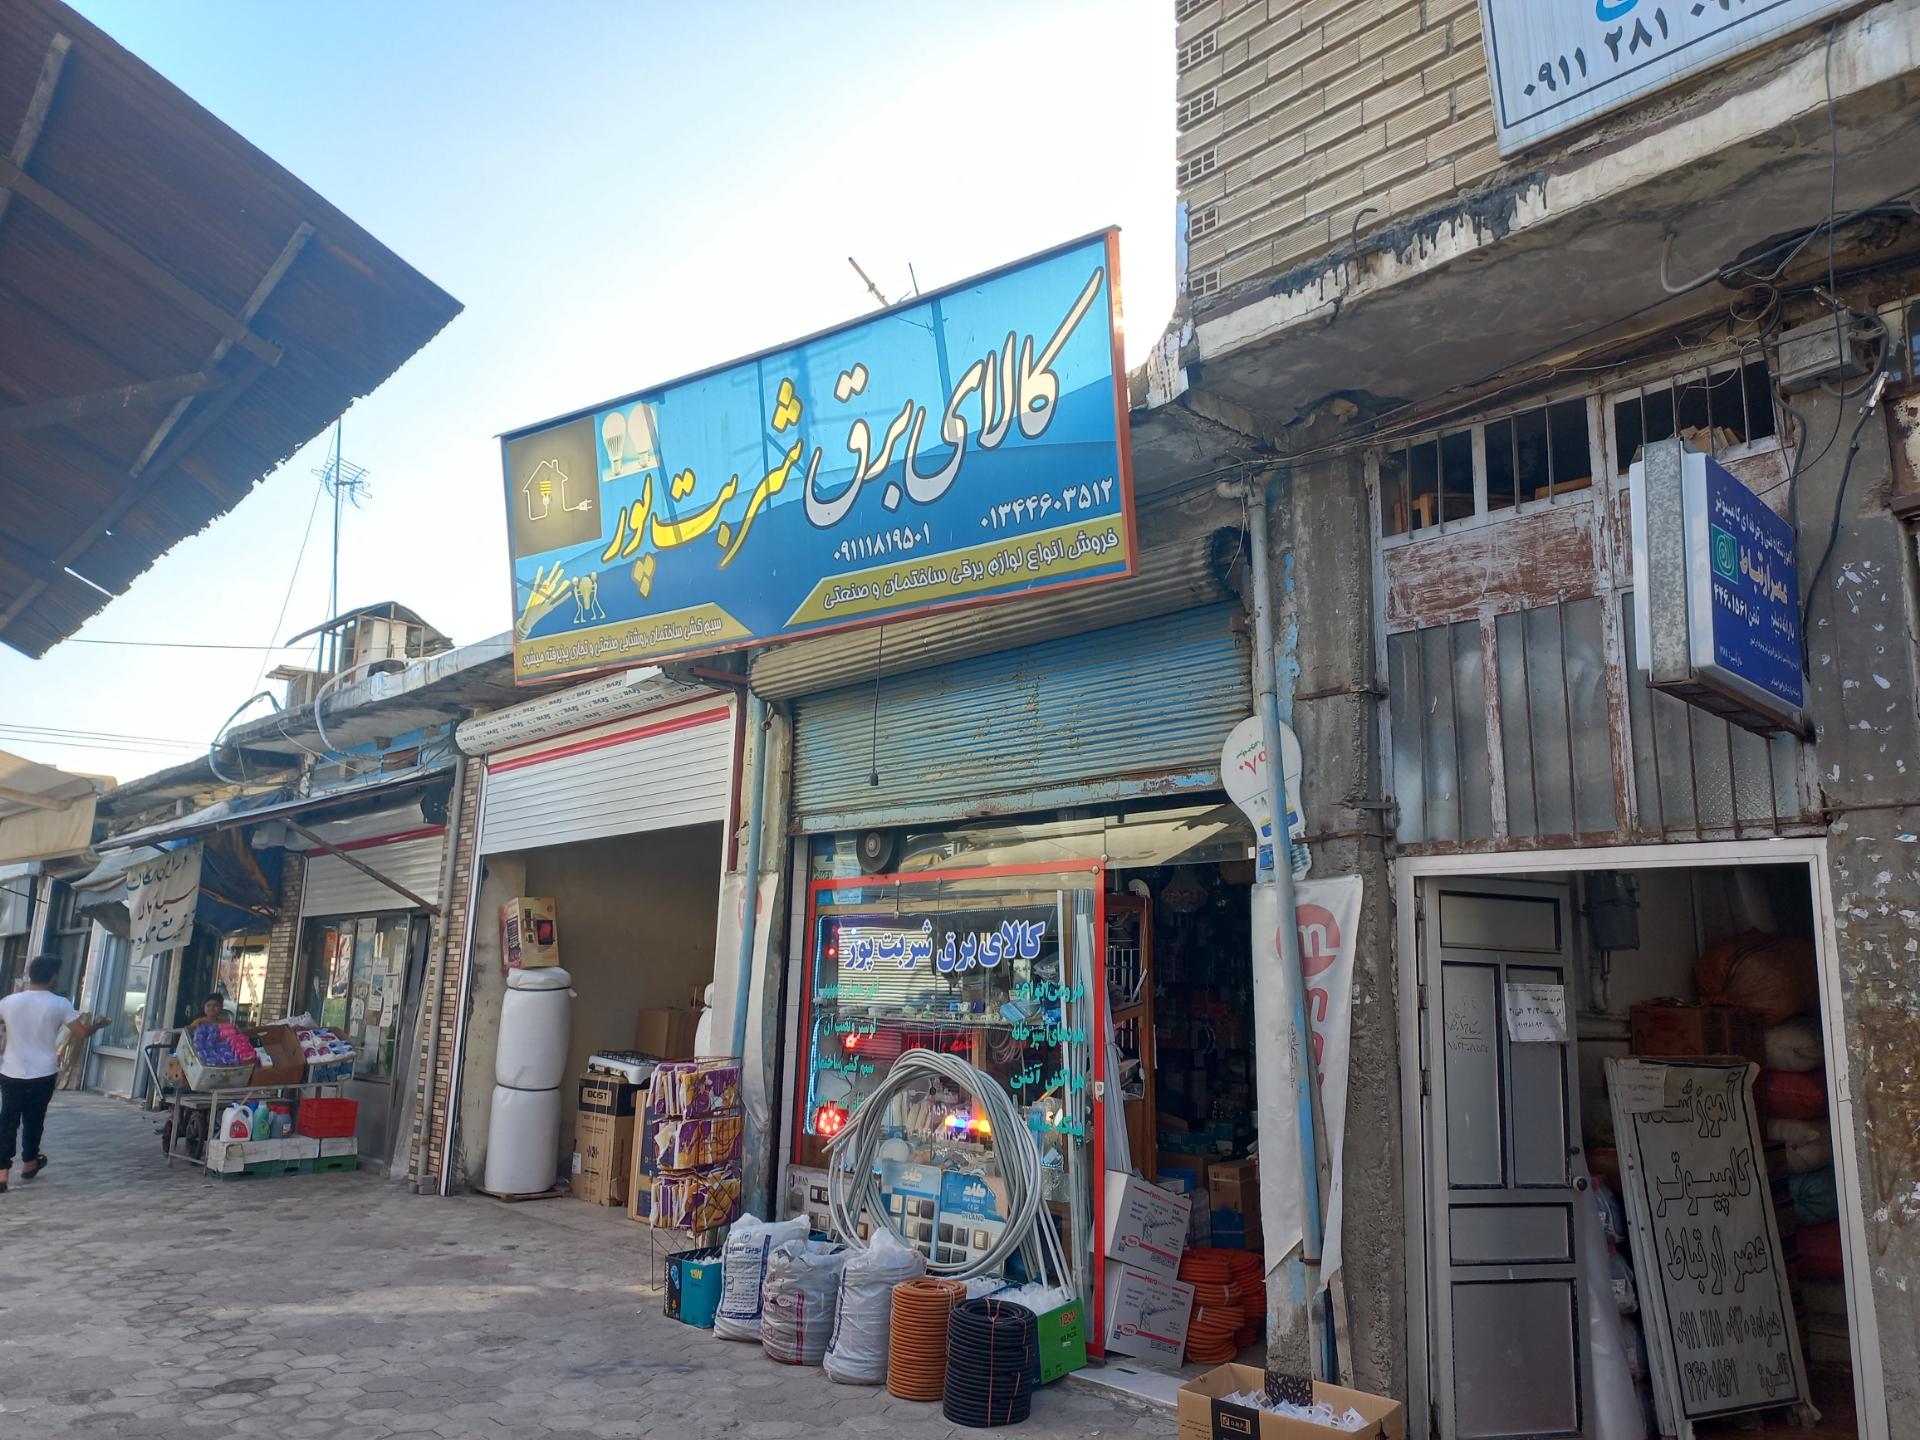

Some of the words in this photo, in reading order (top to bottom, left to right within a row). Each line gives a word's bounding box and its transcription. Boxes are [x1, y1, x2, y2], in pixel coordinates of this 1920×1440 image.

[1523, 47, 1587, 97] ۰۹۱۱
[1604, 8, 1669, 63] ۲۸۱
[904, 265, 1105, 504] کالای
[803, 362, 915, 530] برق
[648, 376, 804, 571] شربت
[980, 476, 1113, 530] ۰۱۳۴۴۶۰۳۵۱۲
[601, 472, 655, 600] پور
[1067, 527, 1119, 560] فروش
[950, 559, 984, 585] برقی
[987, 548, 1023, 577] لوازم
[1028, 539, 1064, 570] انواع
[823, 586, 869, 610] صنعتی
[872, 584, 880, 601] و
[883, 566, 947, 596] ساختمان
[649, 626, 683, 646] ساختمان
[684, 618, 703, 640] کشی
[703, 617, 722, 636] سیم
[595, 638, 618, 657] صنعتی
[844, 936, 876, 971] پور
[877, 919, 933, 969] شربت
[936, 928, 977, 973] برق
[978, 920, 1046, 968] کالای
[1010, 1062, 1043, 1088] آنتن
[1656, 1147, 1751, 1218] کامپیوتر
[1666, 1224, 1727, 1295] ارتباط
[1734, 1235, 1768, 1293] عصر
